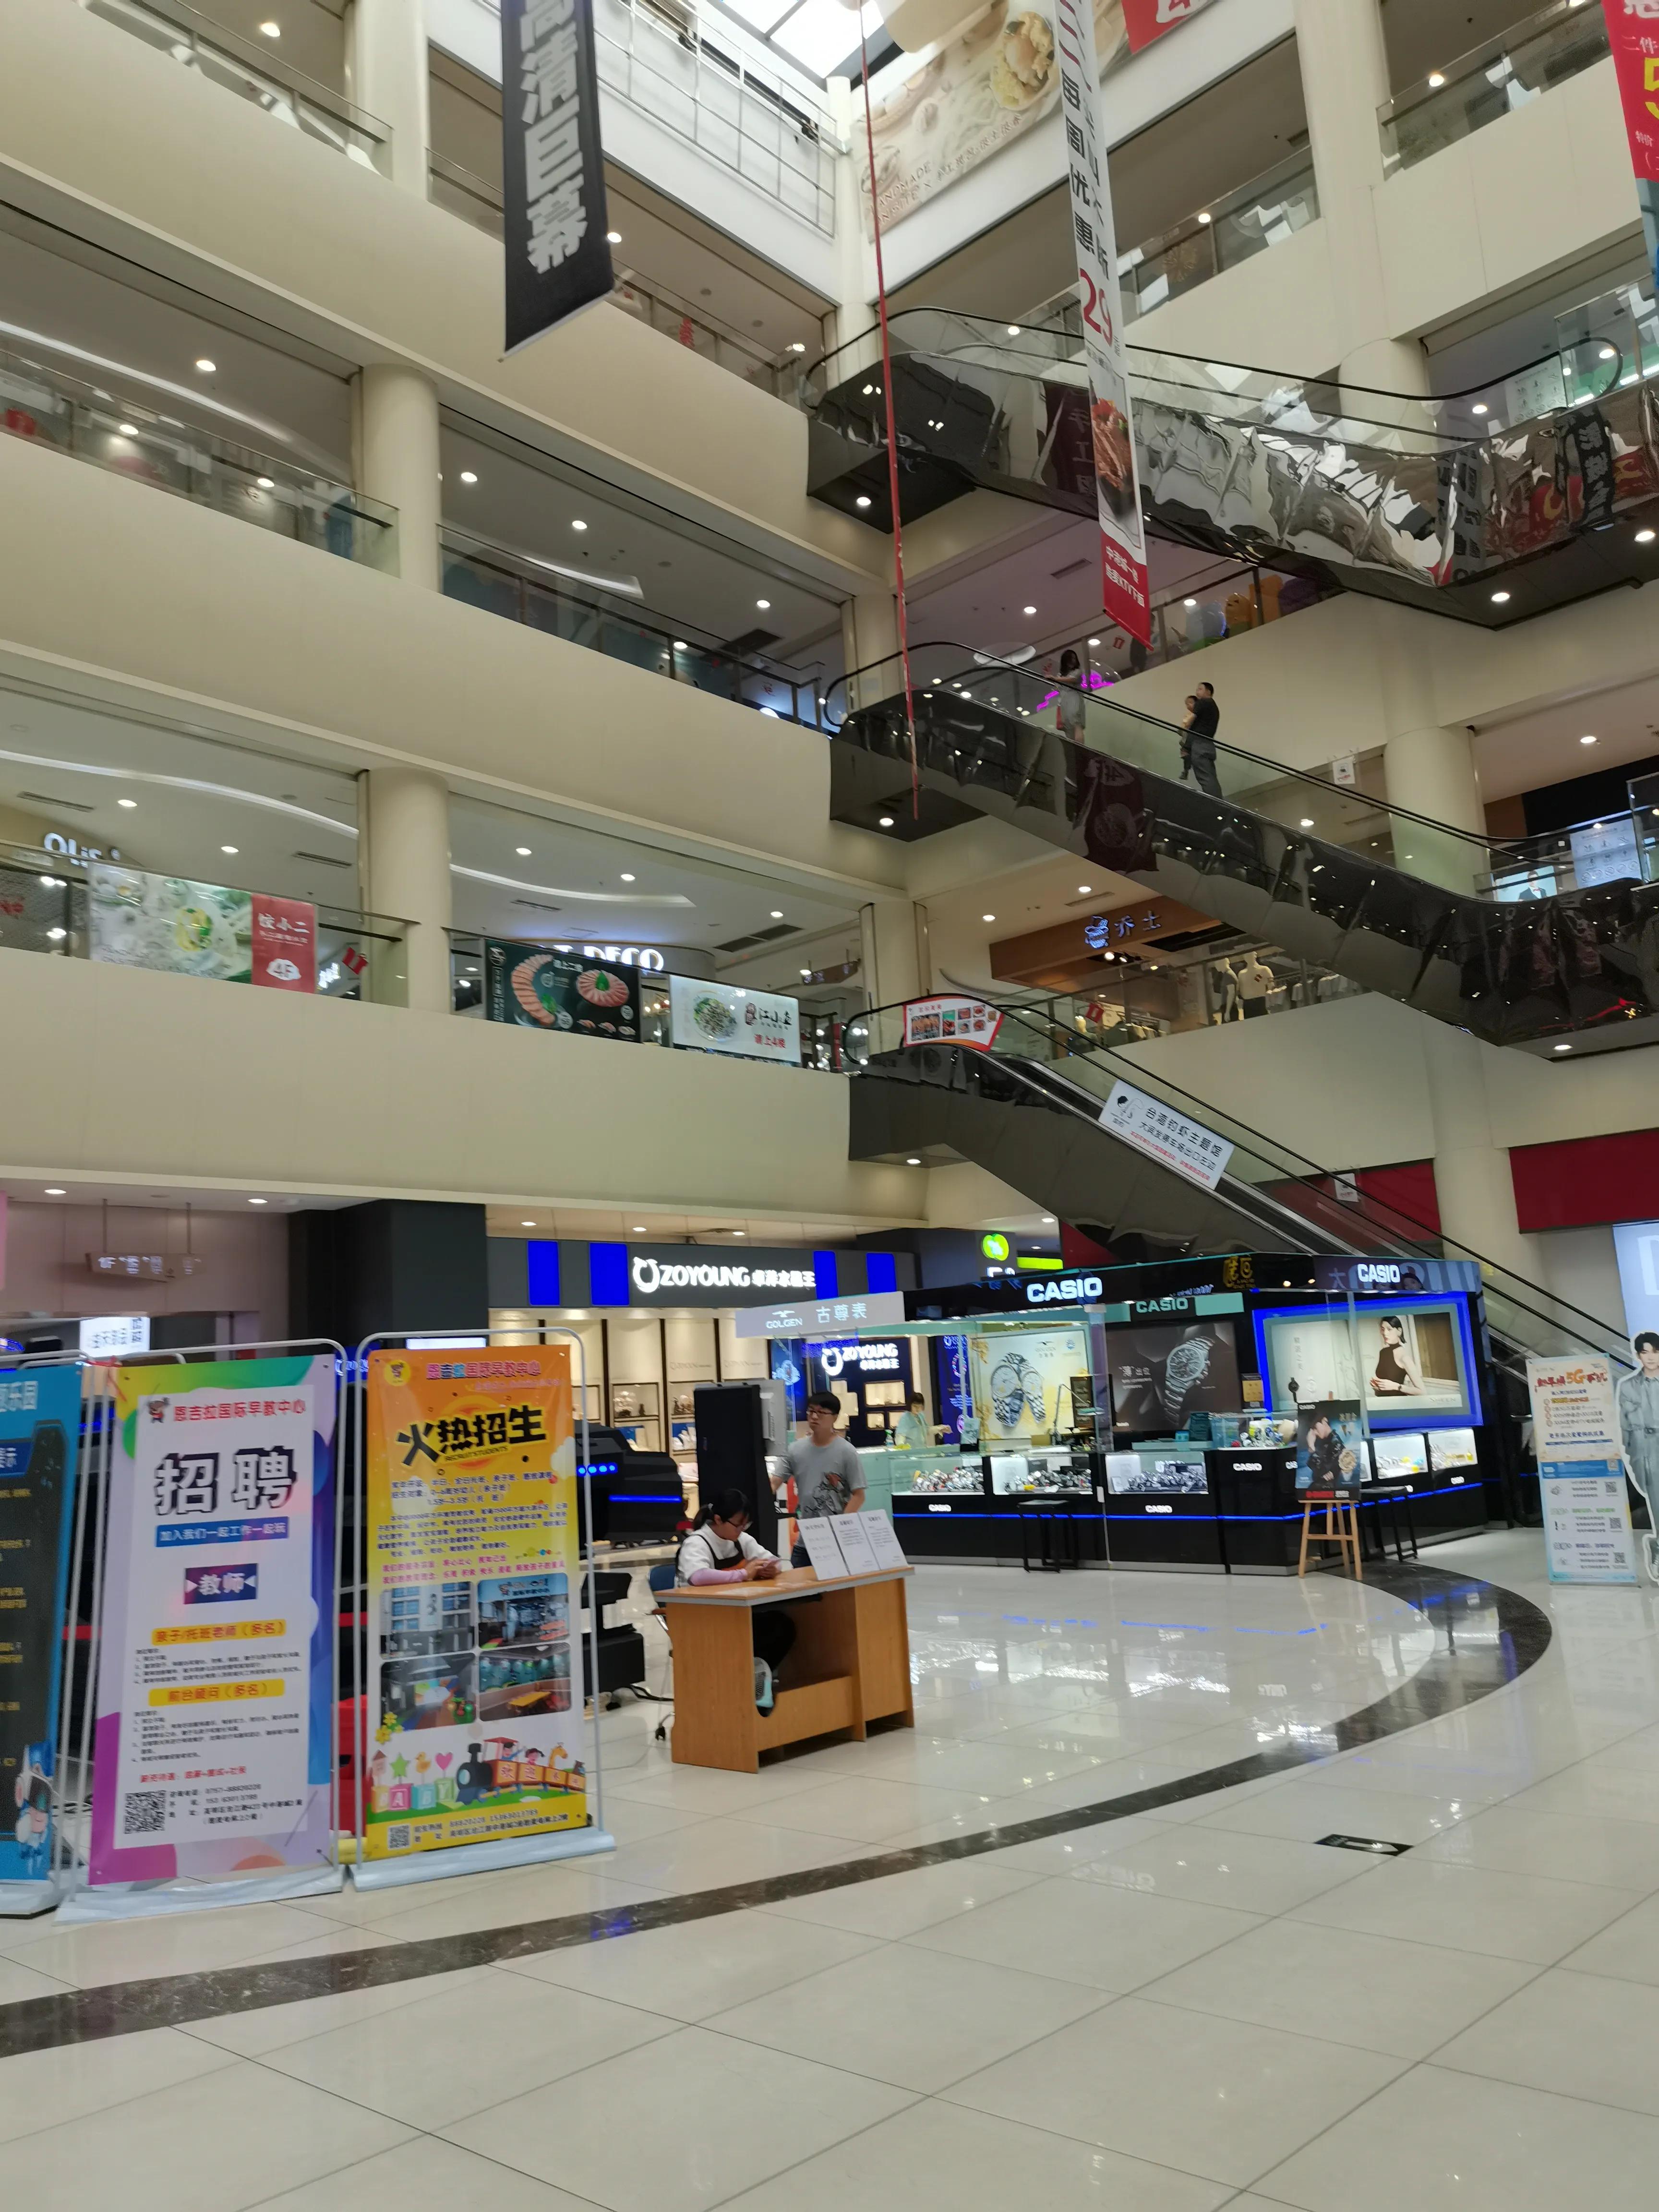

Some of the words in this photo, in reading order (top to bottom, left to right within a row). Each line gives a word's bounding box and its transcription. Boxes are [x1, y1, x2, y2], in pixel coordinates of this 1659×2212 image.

[659, 1264, 751, 1287] ZOYOUNG
[1357, 1263, 1401, 1283] CASIO
[1026, 1276, 1103, 1303] CASIO
[1135, 1298, 1189, 1314] CASIO
[395, 1405, 547, 1467] 火热招生
[1233, 1463, 1262, 1471] CASIO
[154, 1445, 298, 1516] 招聘
